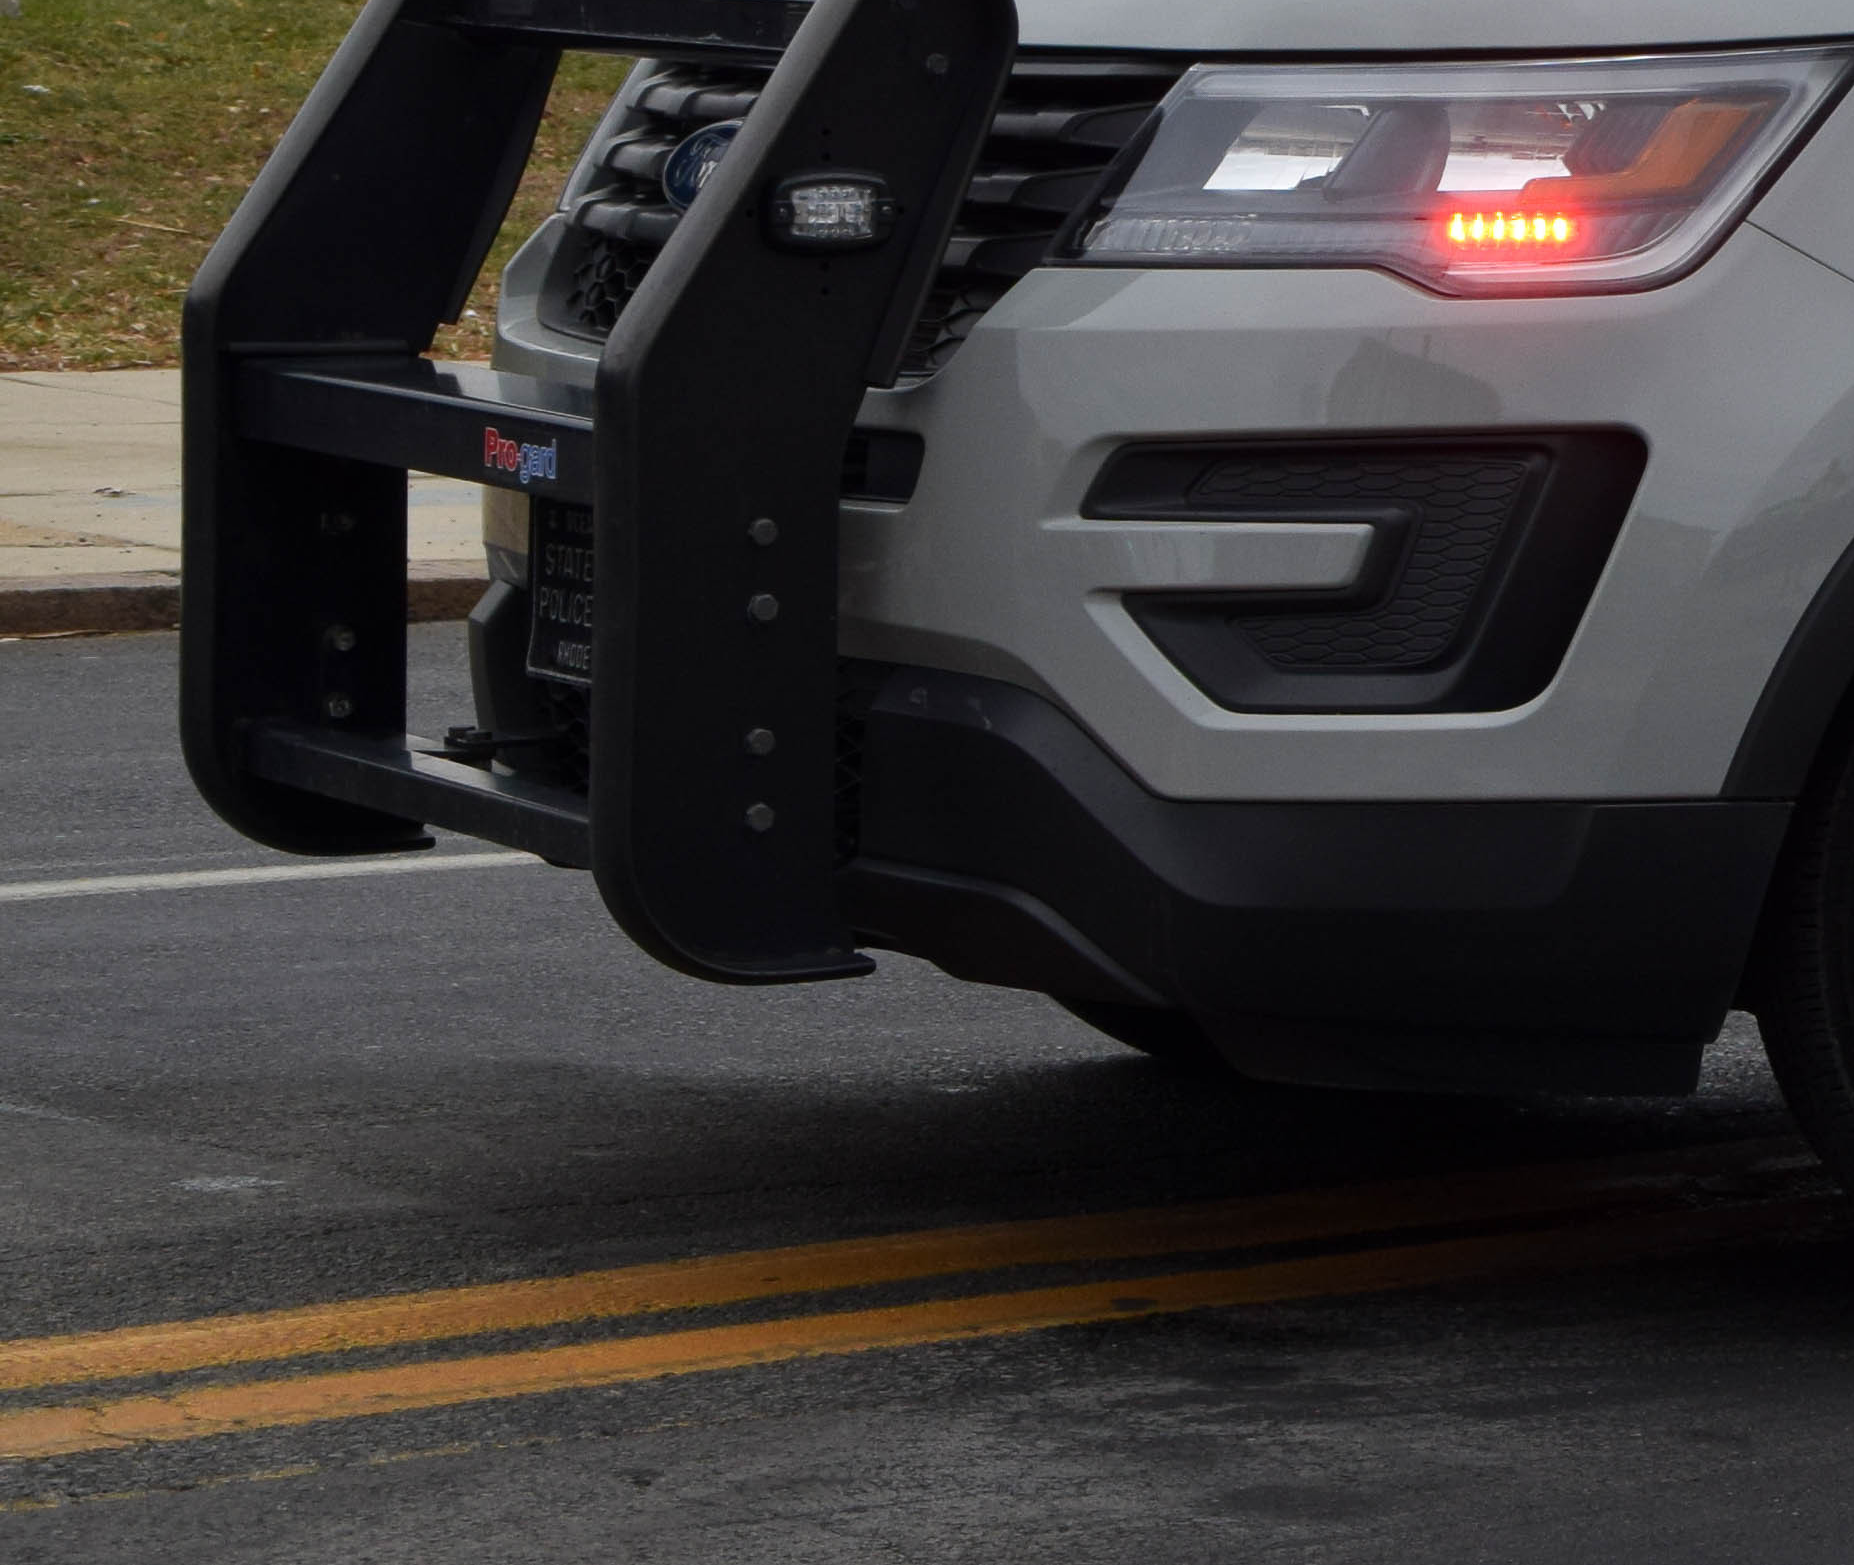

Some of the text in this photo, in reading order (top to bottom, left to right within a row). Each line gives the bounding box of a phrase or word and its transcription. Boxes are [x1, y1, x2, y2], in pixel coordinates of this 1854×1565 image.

[484, 426, 557, 484] Pro-gard
[544, 542, 593, 583] STATE
[538, 585, 593, 628] POLICE
